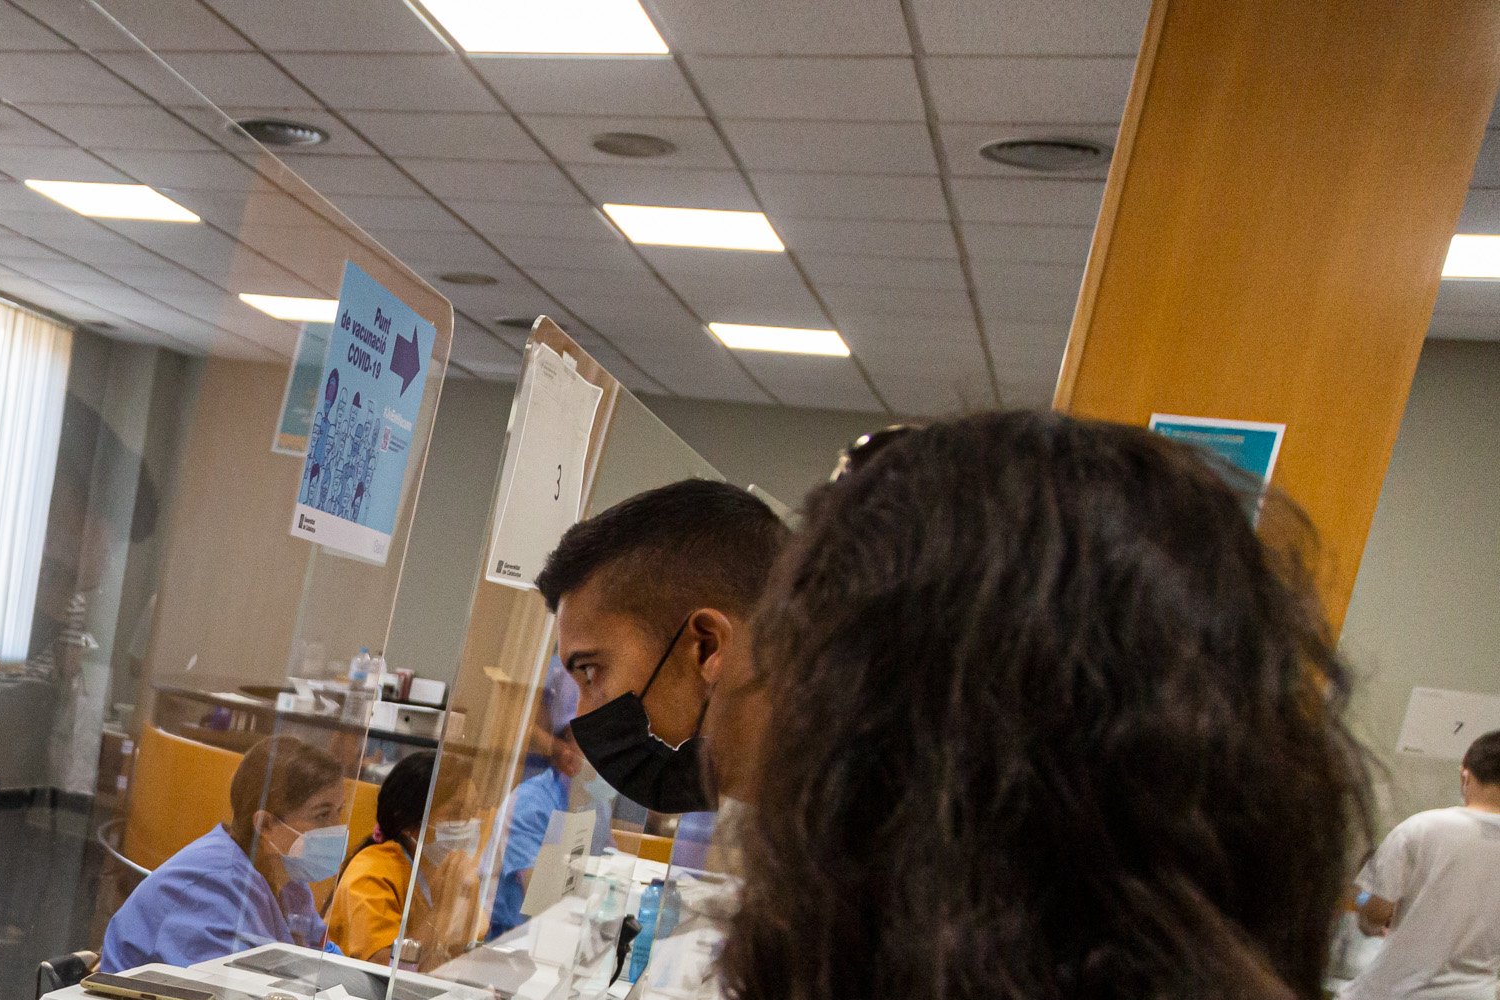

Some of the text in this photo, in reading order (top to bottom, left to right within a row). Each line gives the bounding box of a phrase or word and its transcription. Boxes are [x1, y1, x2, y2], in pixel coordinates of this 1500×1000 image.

[341, 309, 387, 355] de vacunació
[374, 307, 392, 335] Punt
[348, 342, 382, 380] COVID-19
[554, 464, 562, 501] 3
[1453, 720, 1464, 735] 7
